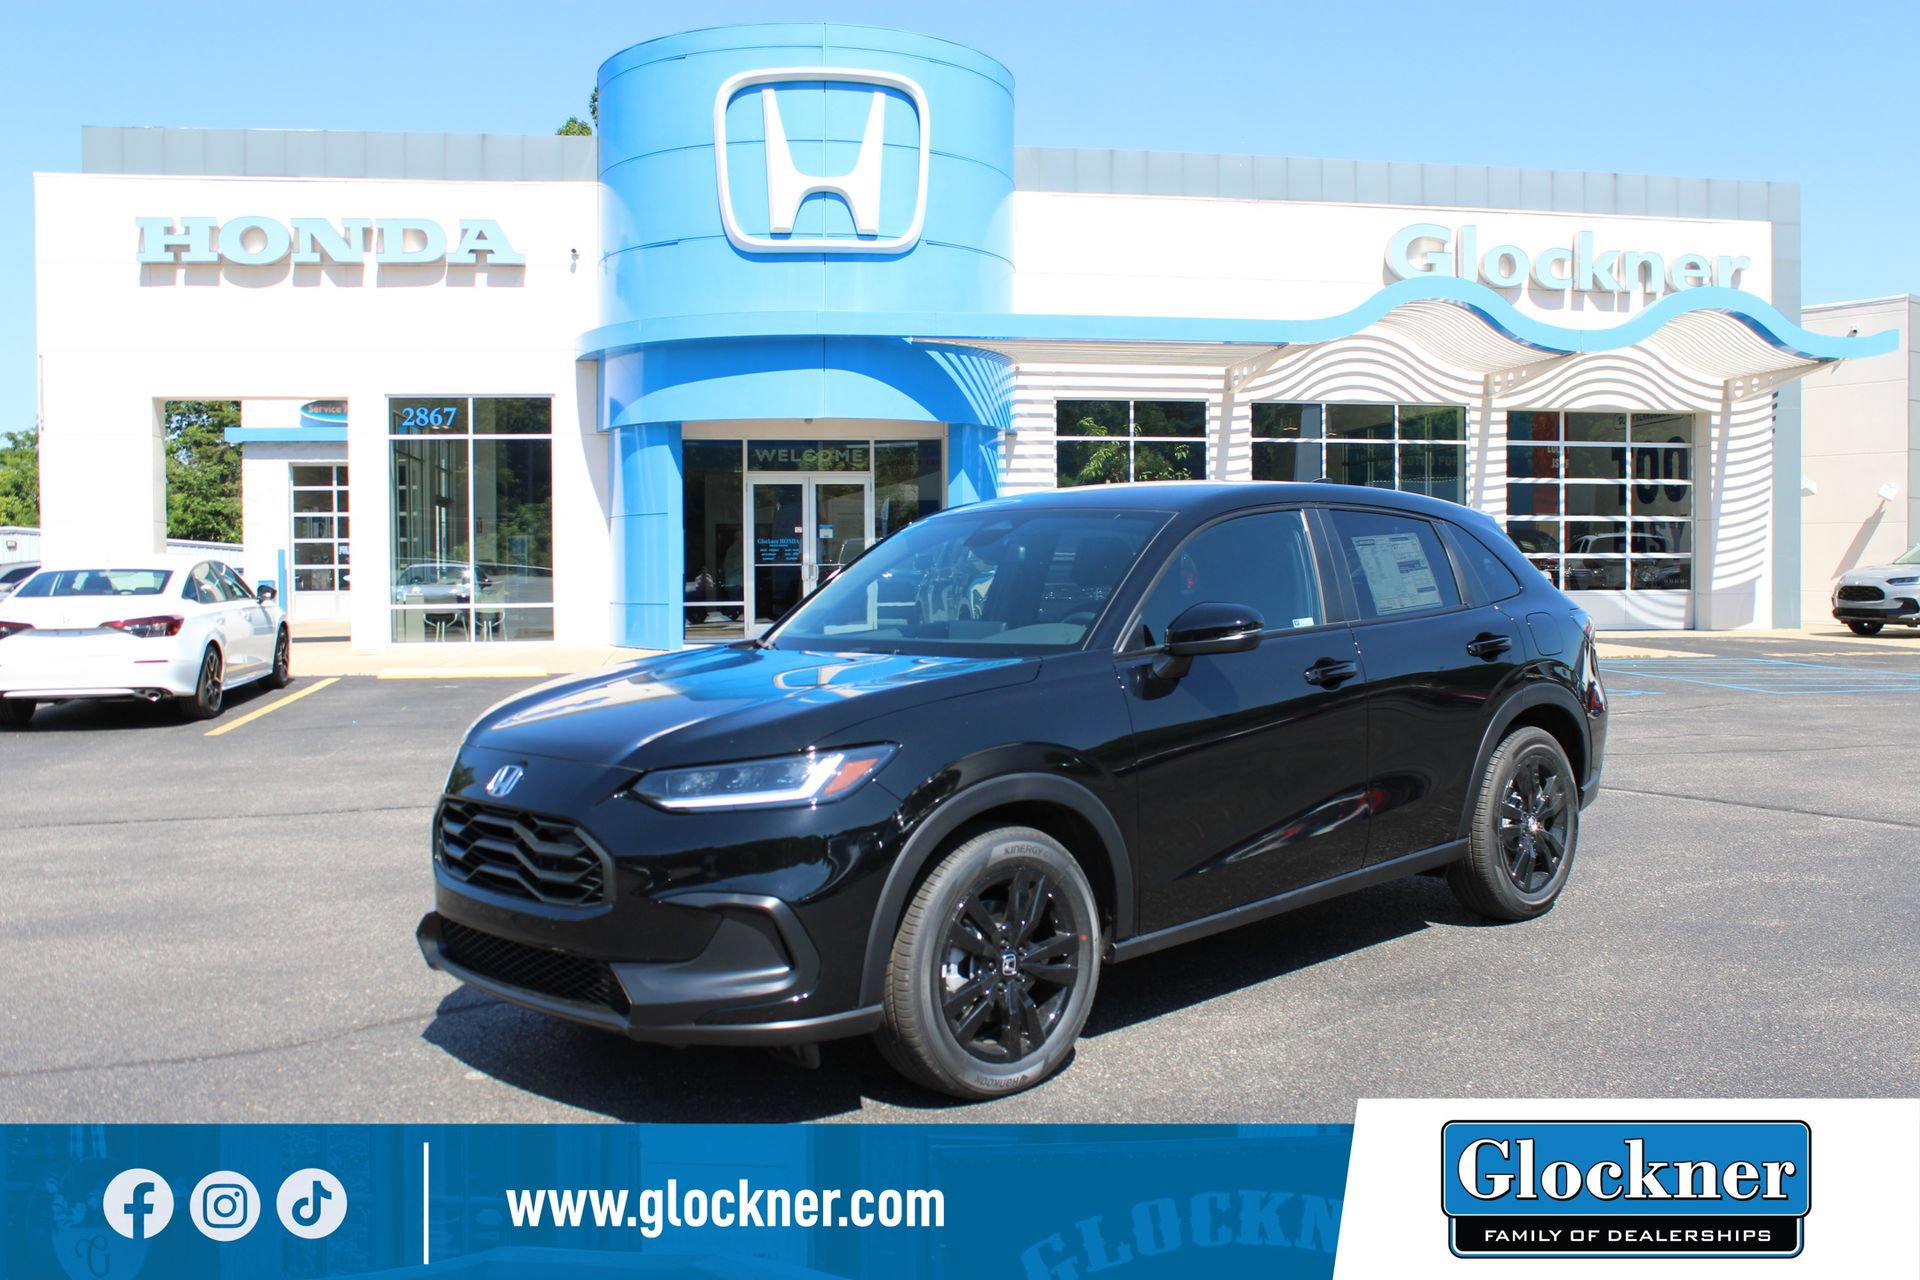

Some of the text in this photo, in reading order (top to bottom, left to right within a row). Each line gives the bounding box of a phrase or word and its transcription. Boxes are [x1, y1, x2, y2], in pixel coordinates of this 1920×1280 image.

[135, 215, 526, 265] HONDA
[1384, 223, 1750, 292] Glockner
[308, 404, 341, 414] Service
[402, 407, 457, 426] 2867
[755, 448, 864, 463] WELCOME
